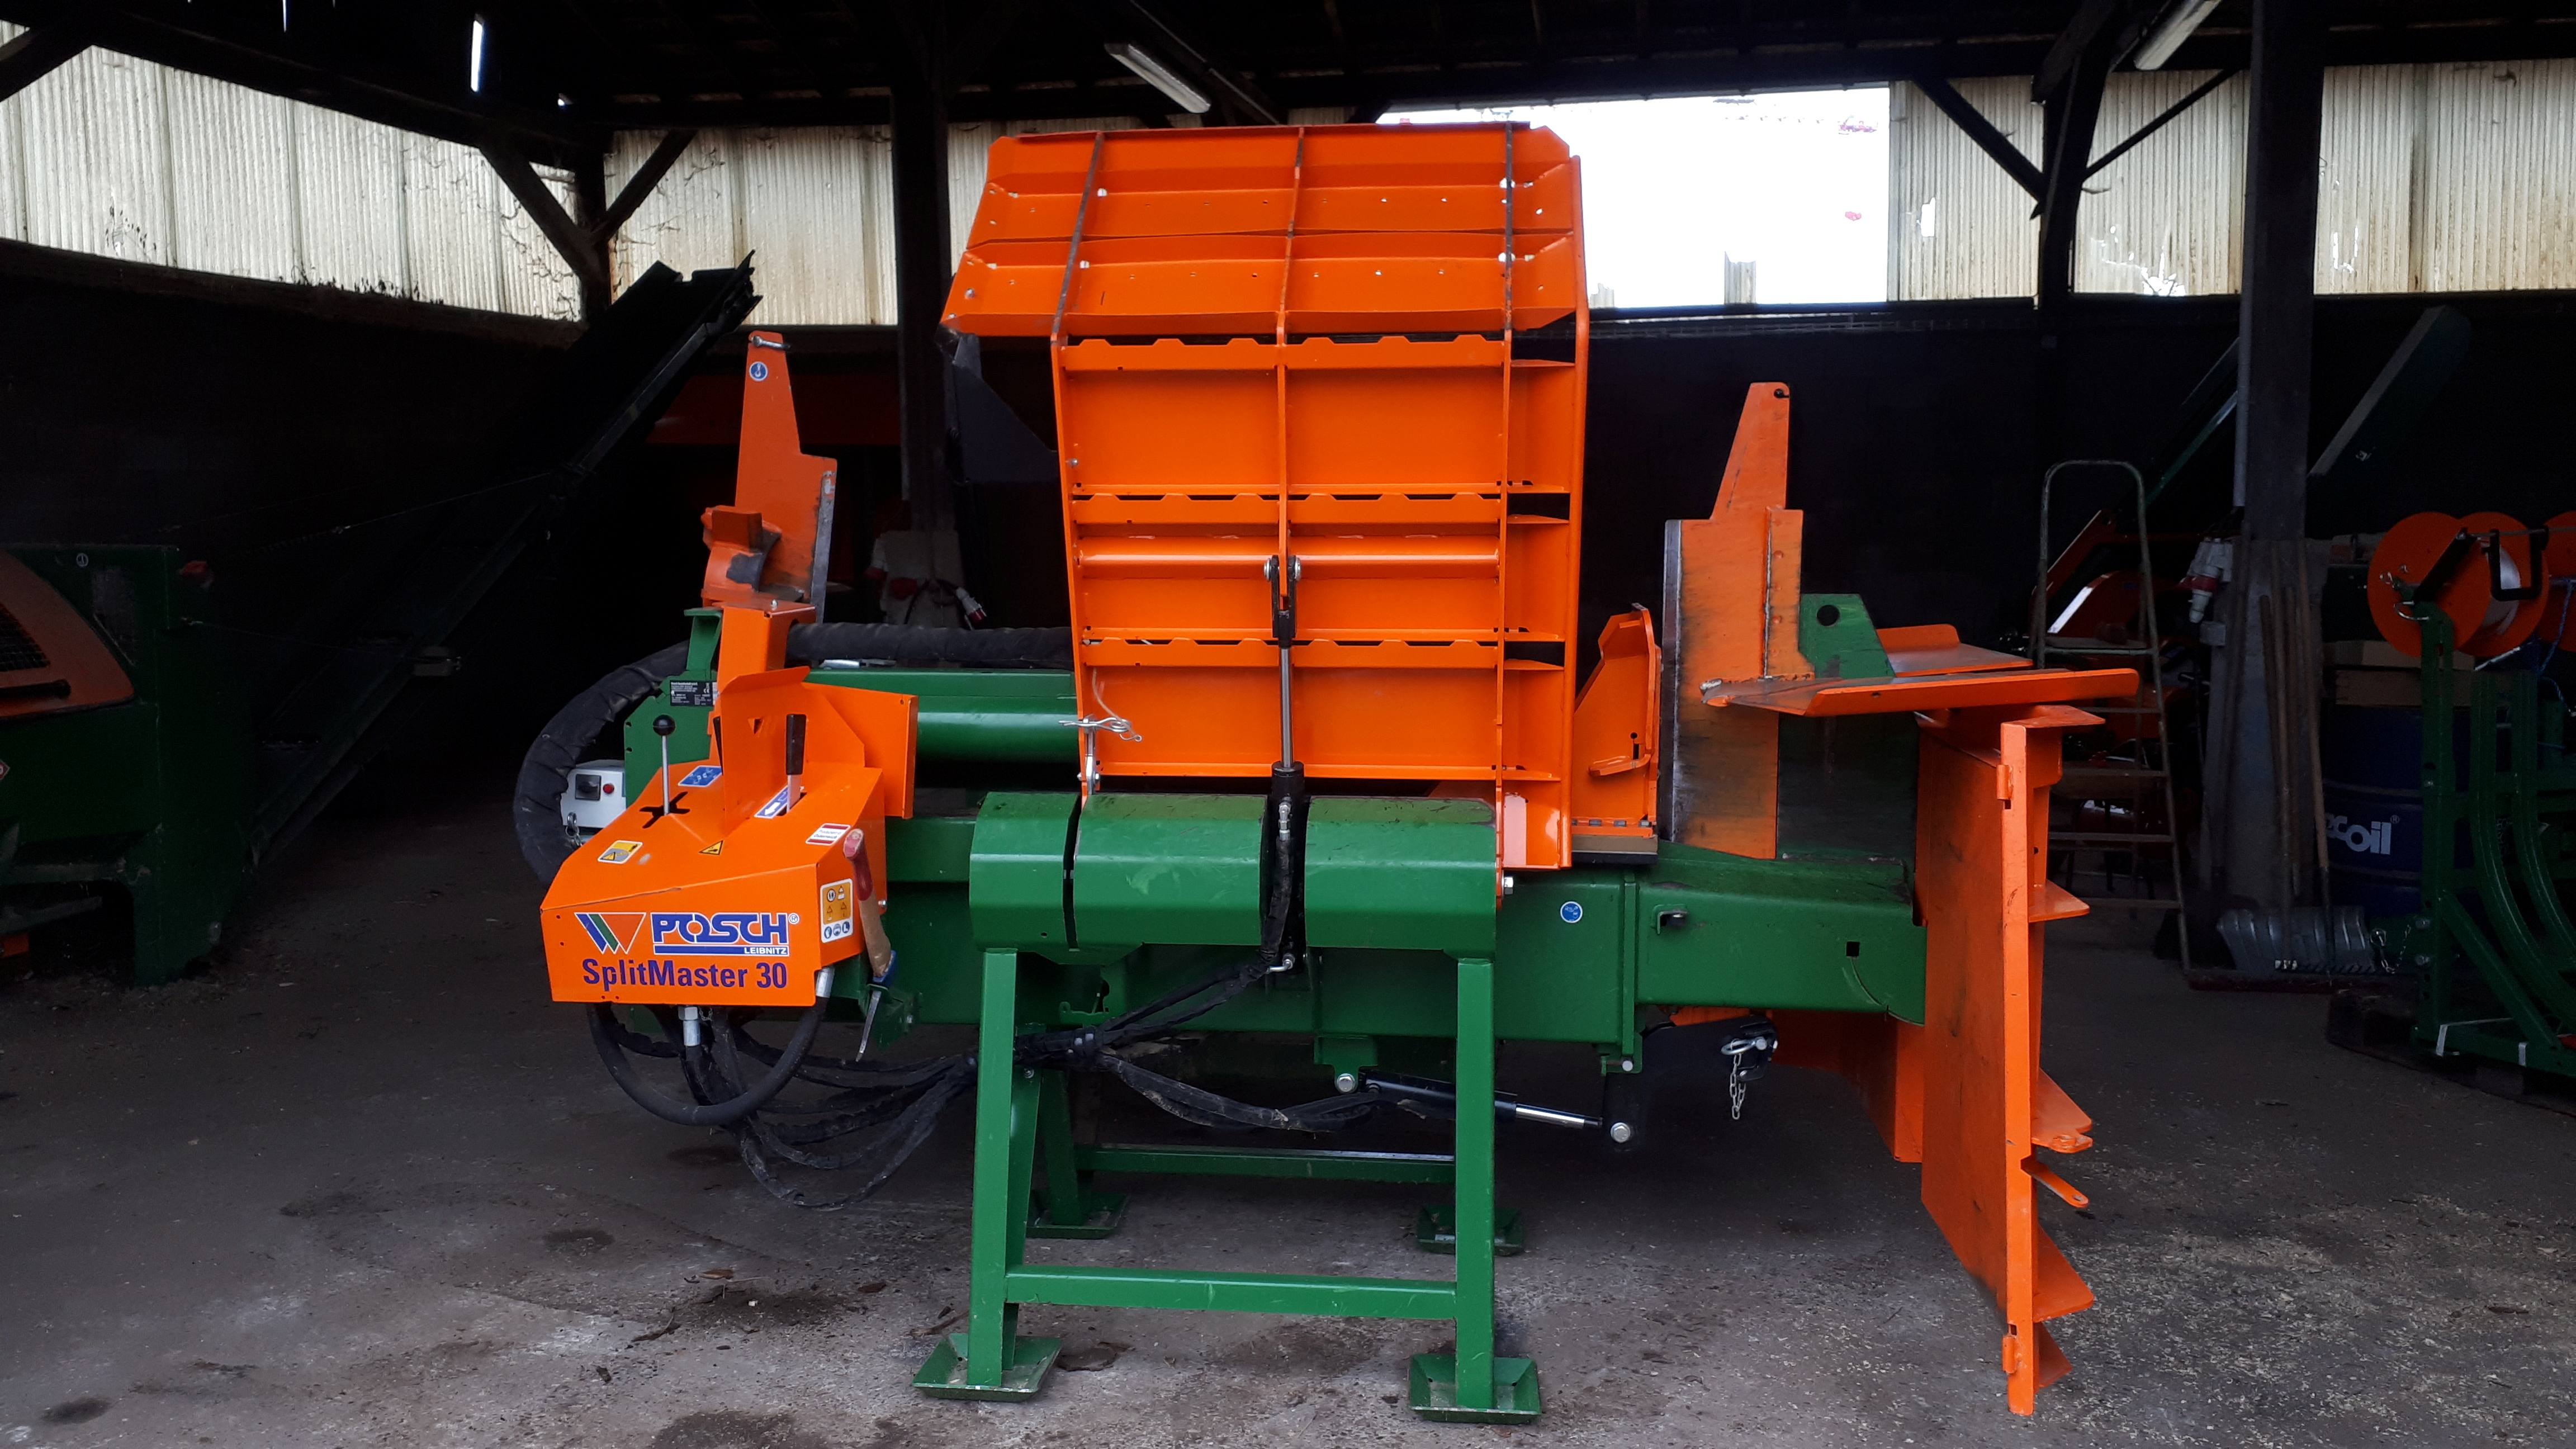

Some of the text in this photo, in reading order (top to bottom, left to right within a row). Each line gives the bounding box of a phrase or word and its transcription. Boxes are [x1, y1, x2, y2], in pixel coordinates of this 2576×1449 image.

[651, 912, 789, 944] POSCH
[583, 958, 787, 991] SplitMaster 30
